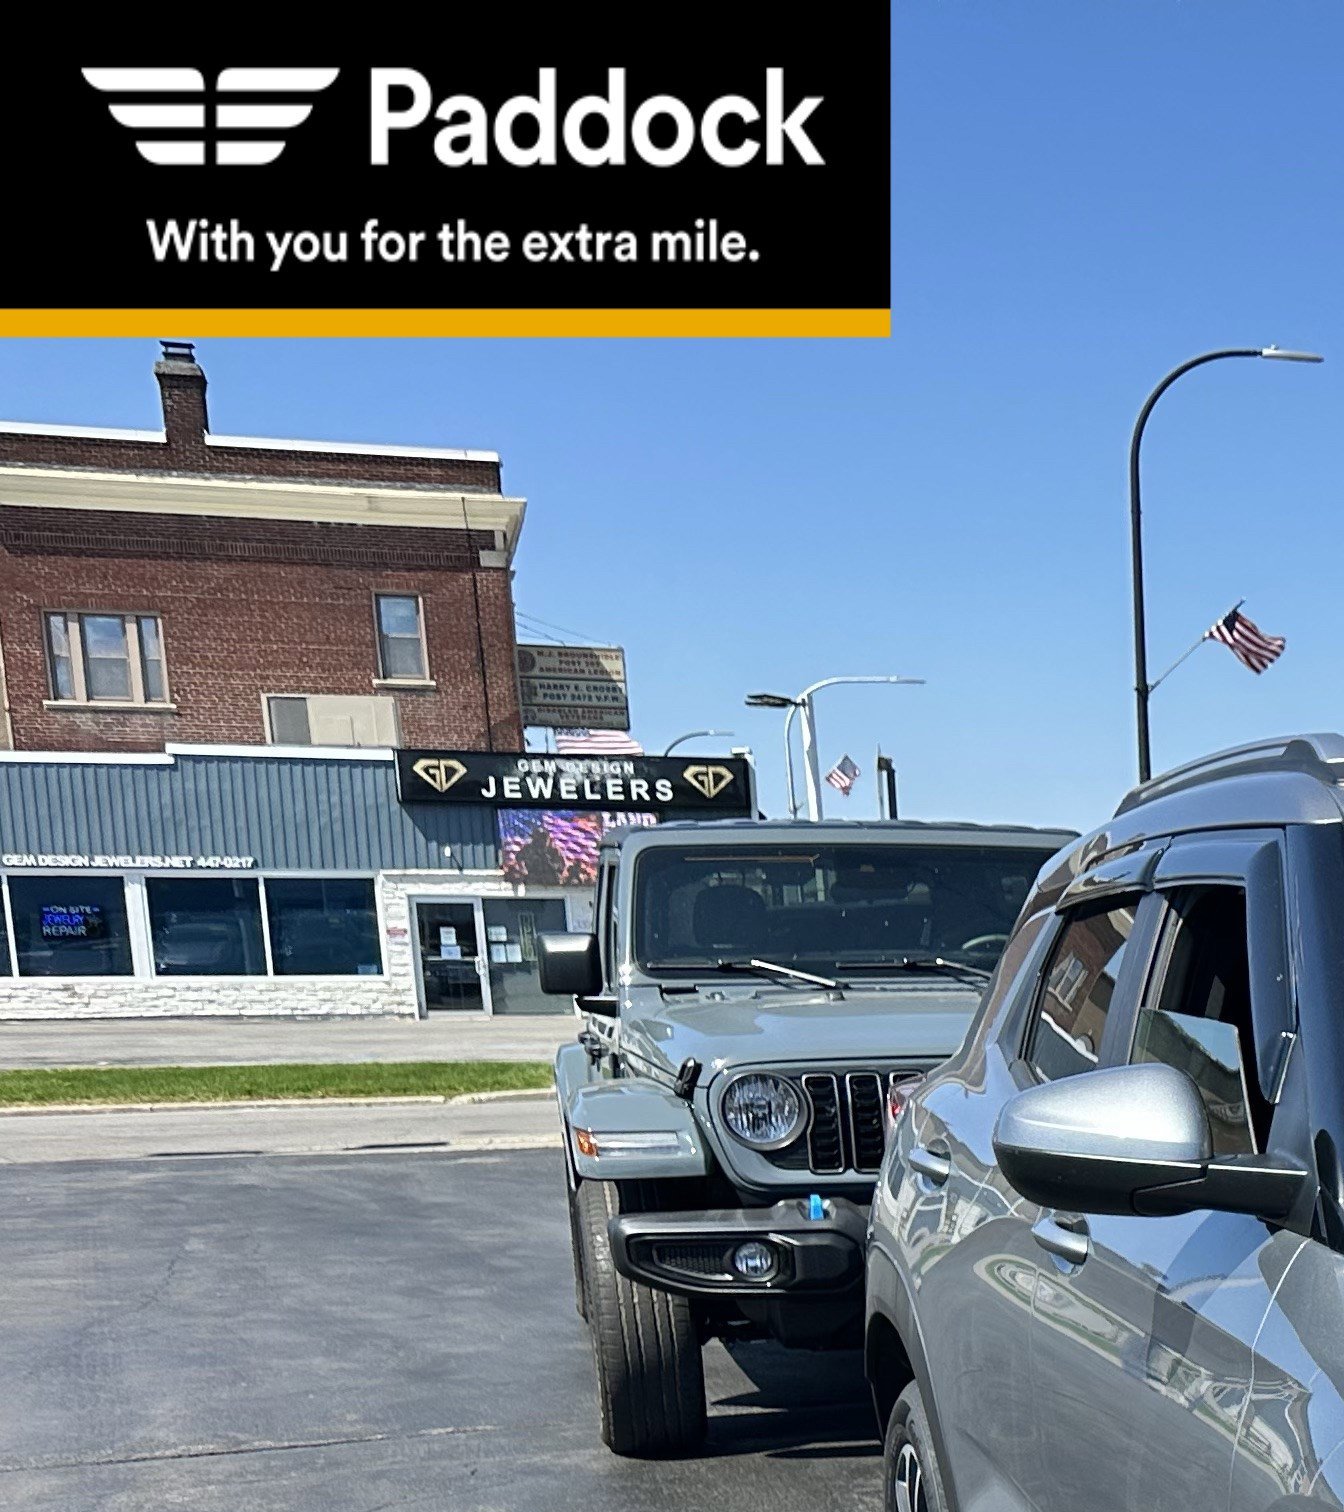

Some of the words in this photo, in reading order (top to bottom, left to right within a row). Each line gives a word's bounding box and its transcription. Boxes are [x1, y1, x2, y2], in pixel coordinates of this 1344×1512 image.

[543, 692, 567, 700] POST
[517, 759, 556, 773] GEM
[565, 760, 635, 775] DESIGN
[481, 776, 674, 801] JEWELERS
[2, 854, 38, 867] GEM
[38, 854, 91, 867] DESIGN
[90, 855, 193, 868] JEWELERS.NET
[196, 856, 255, 868] 447-0217
[42, 925, 87, 937] REPAIR
